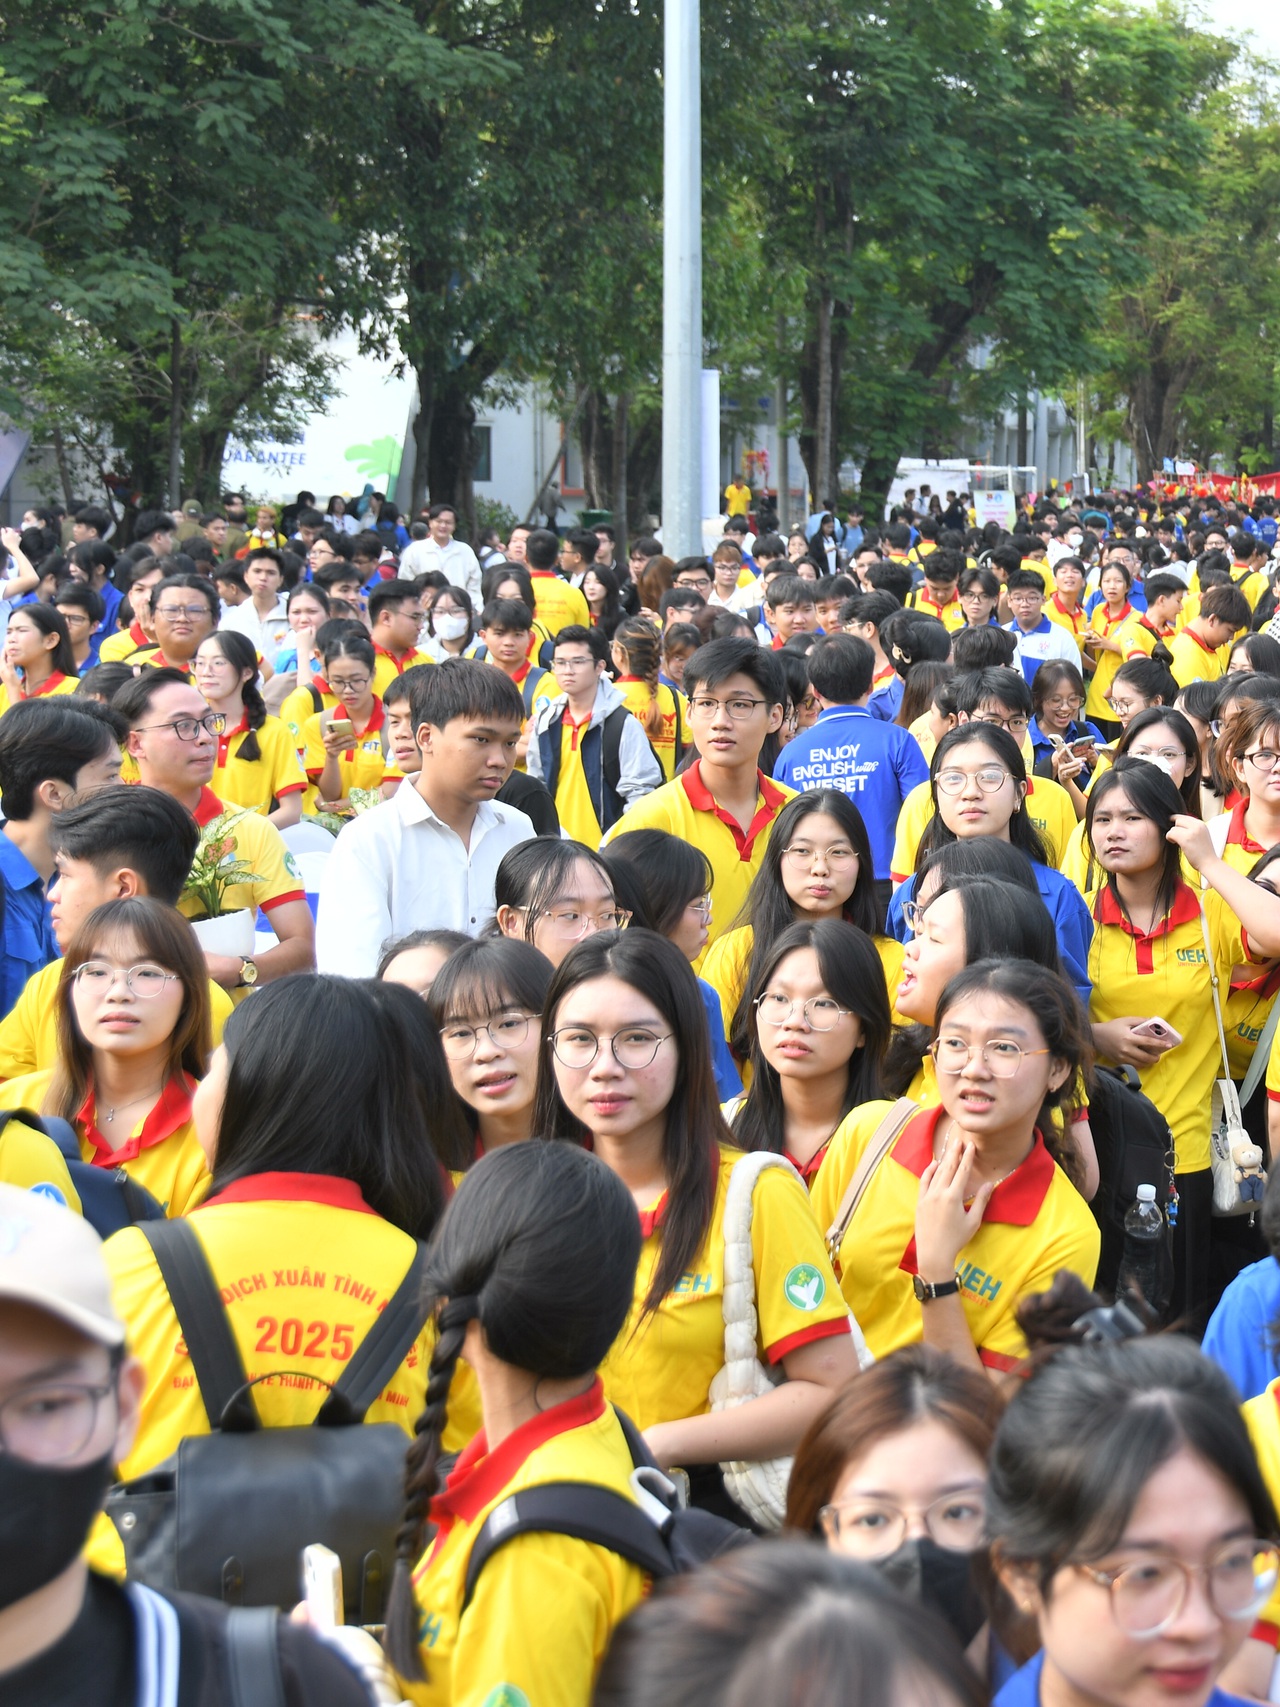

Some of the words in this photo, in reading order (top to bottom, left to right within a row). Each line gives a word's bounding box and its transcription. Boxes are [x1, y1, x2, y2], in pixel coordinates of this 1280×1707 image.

[222, 447, 306, 465] UARANTEE
[810, 743, 860, 762] ENJOY
[793, 760, 856, 781] ENGLISH
[855, 761, 879, 773] with
[1176, 949, 1207, 963] UEH
[273, 1265, 327, 1288] XUÂN
[334, 1274, 378, 1306] TÌNH
[673, 1272, 712, 1293] EH
[255, 1316, 355, 1361] 2025
